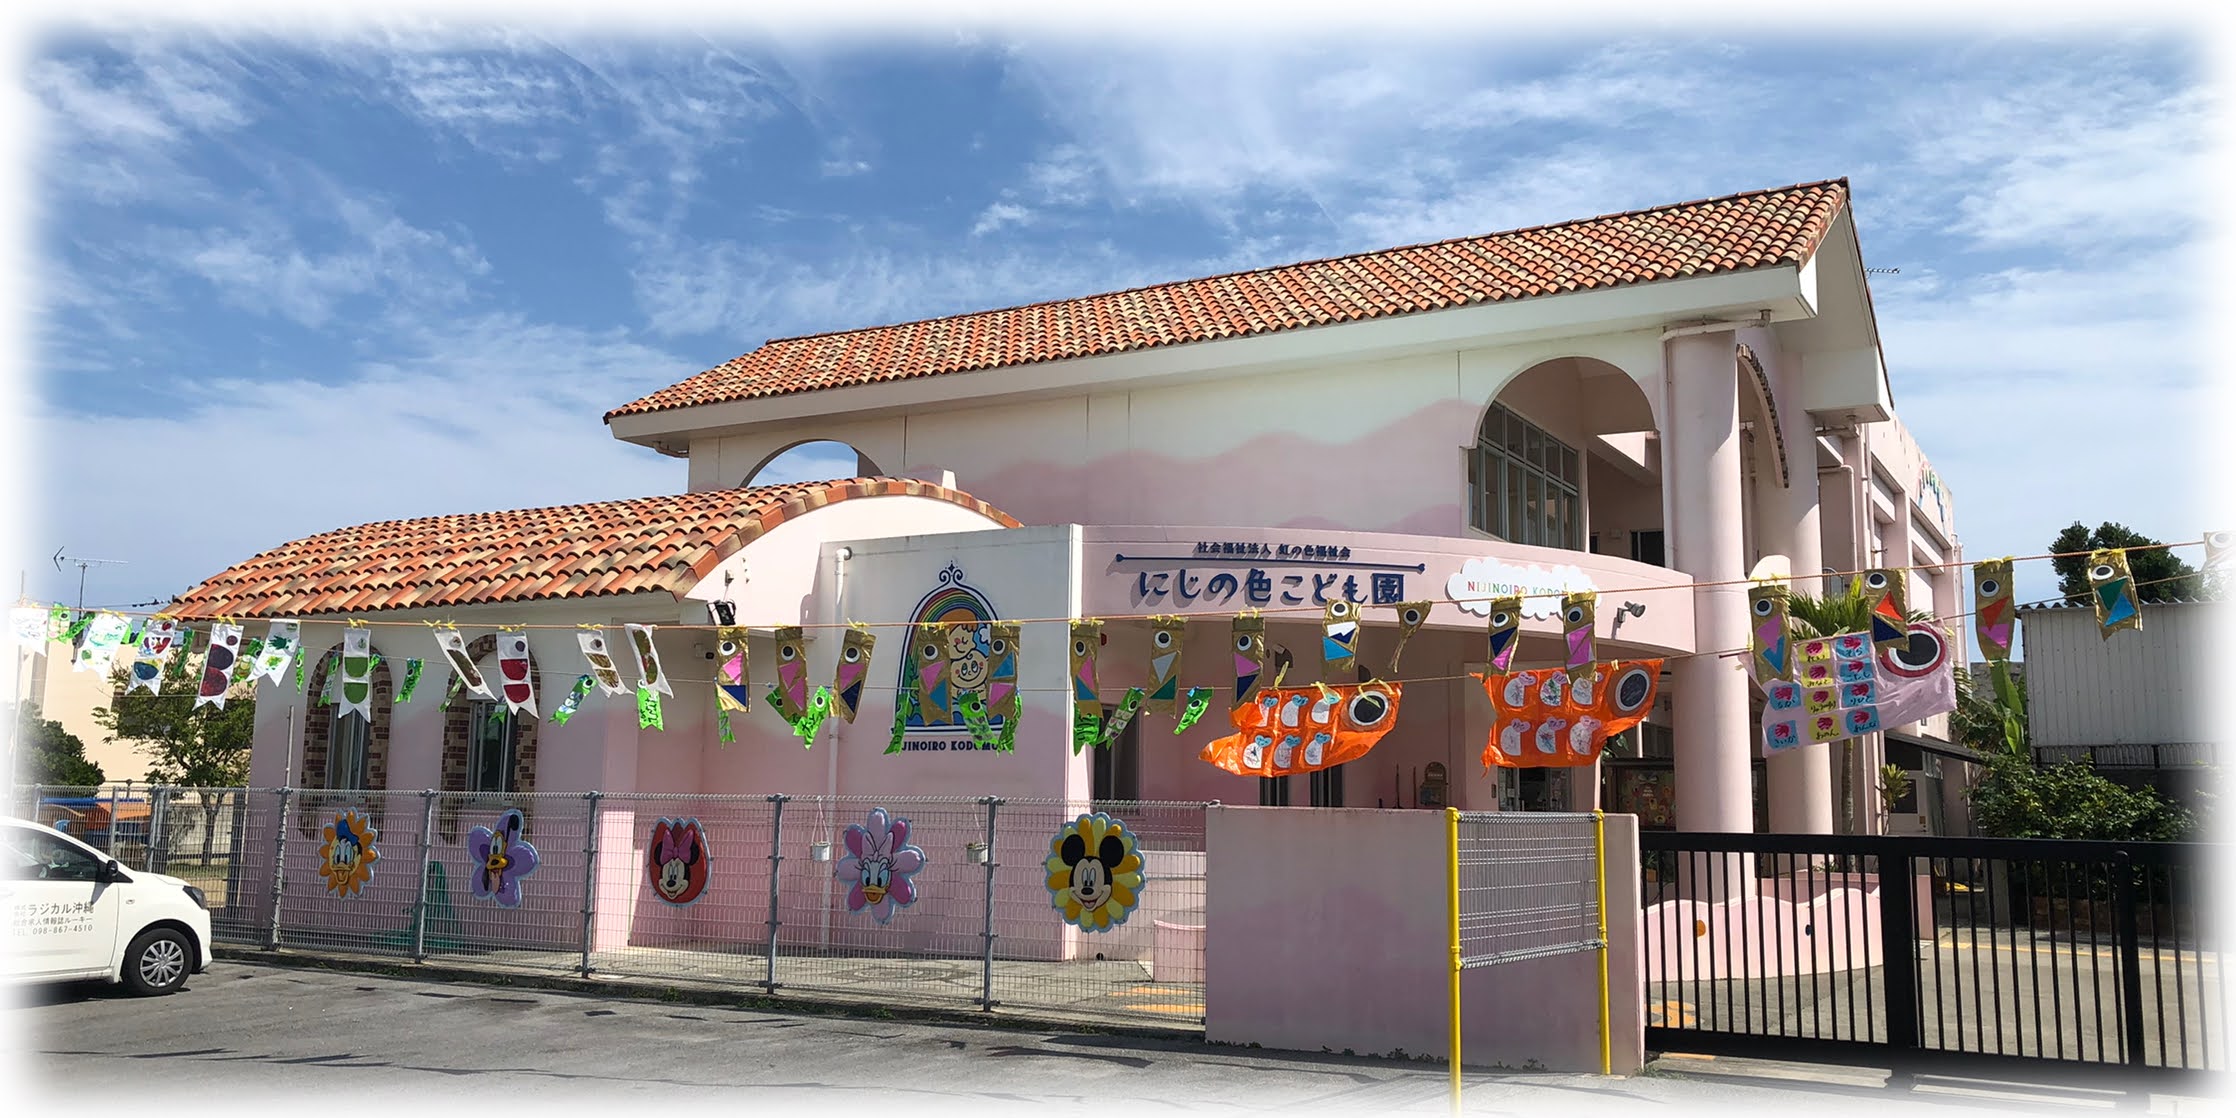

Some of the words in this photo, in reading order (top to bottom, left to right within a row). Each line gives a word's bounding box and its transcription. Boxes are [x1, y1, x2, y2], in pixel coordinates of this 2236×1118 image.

[1198, 541, 1272, 555] 社会福祉法人
[1138, 567, 1405, 604] にじの色こども園
[901, 740, 947, 751] JINOIRO
[28, 900, 94, 916] ラジカル沖縄
[32, 924, 93, 935] 098-867-4510
